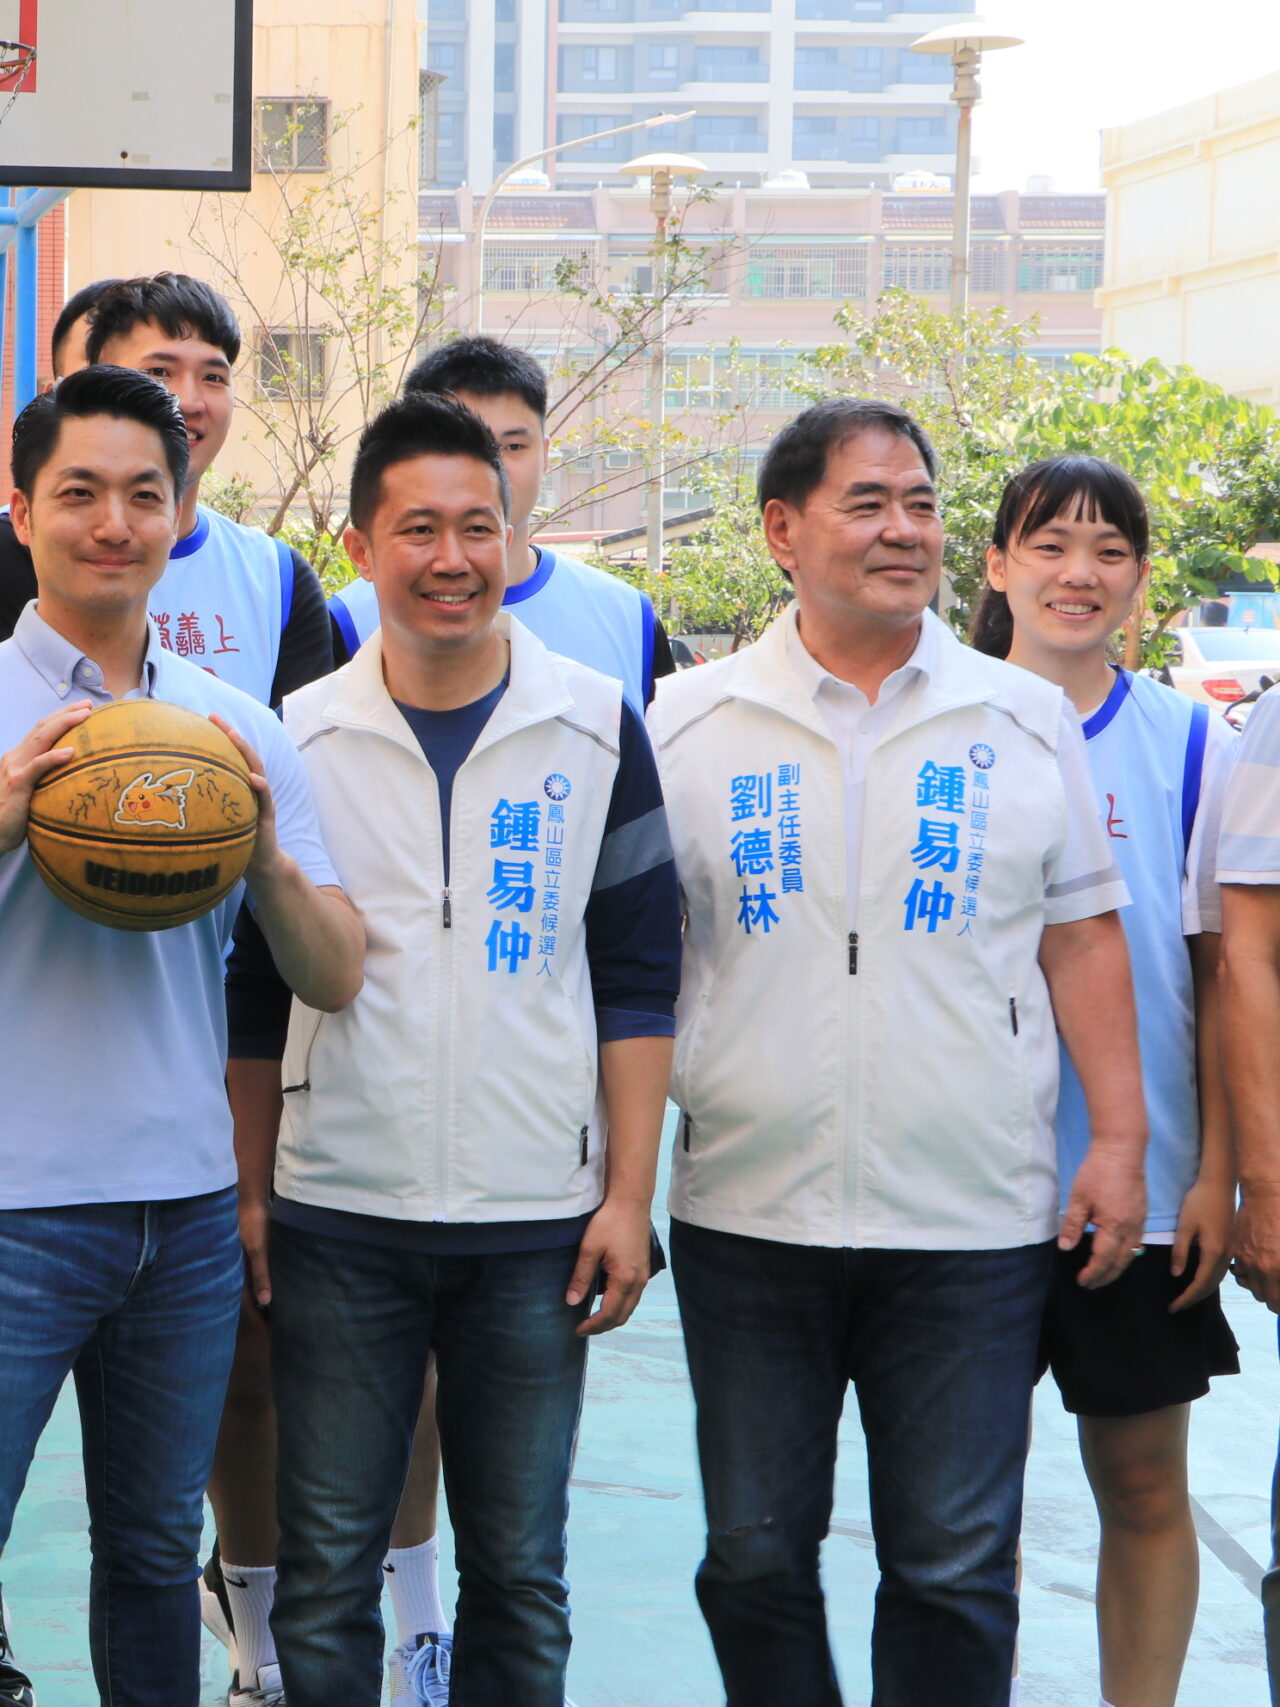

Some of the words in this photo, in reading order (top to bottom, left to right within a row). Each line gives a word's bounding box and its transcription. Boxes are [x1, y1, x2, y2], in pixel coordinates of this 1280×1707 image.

[484, 798, 541, 974] 鍾易仲
[536, 804, 565, 977] 鳳山區立委候選人
[729, 772, 780, 935] 劉德林
[777, 762, 804, 895] 副主任委員
[903, 759, 967, 934] 鍾易仲
[956, 771, 990, 938] 鳳山區立委候選人
